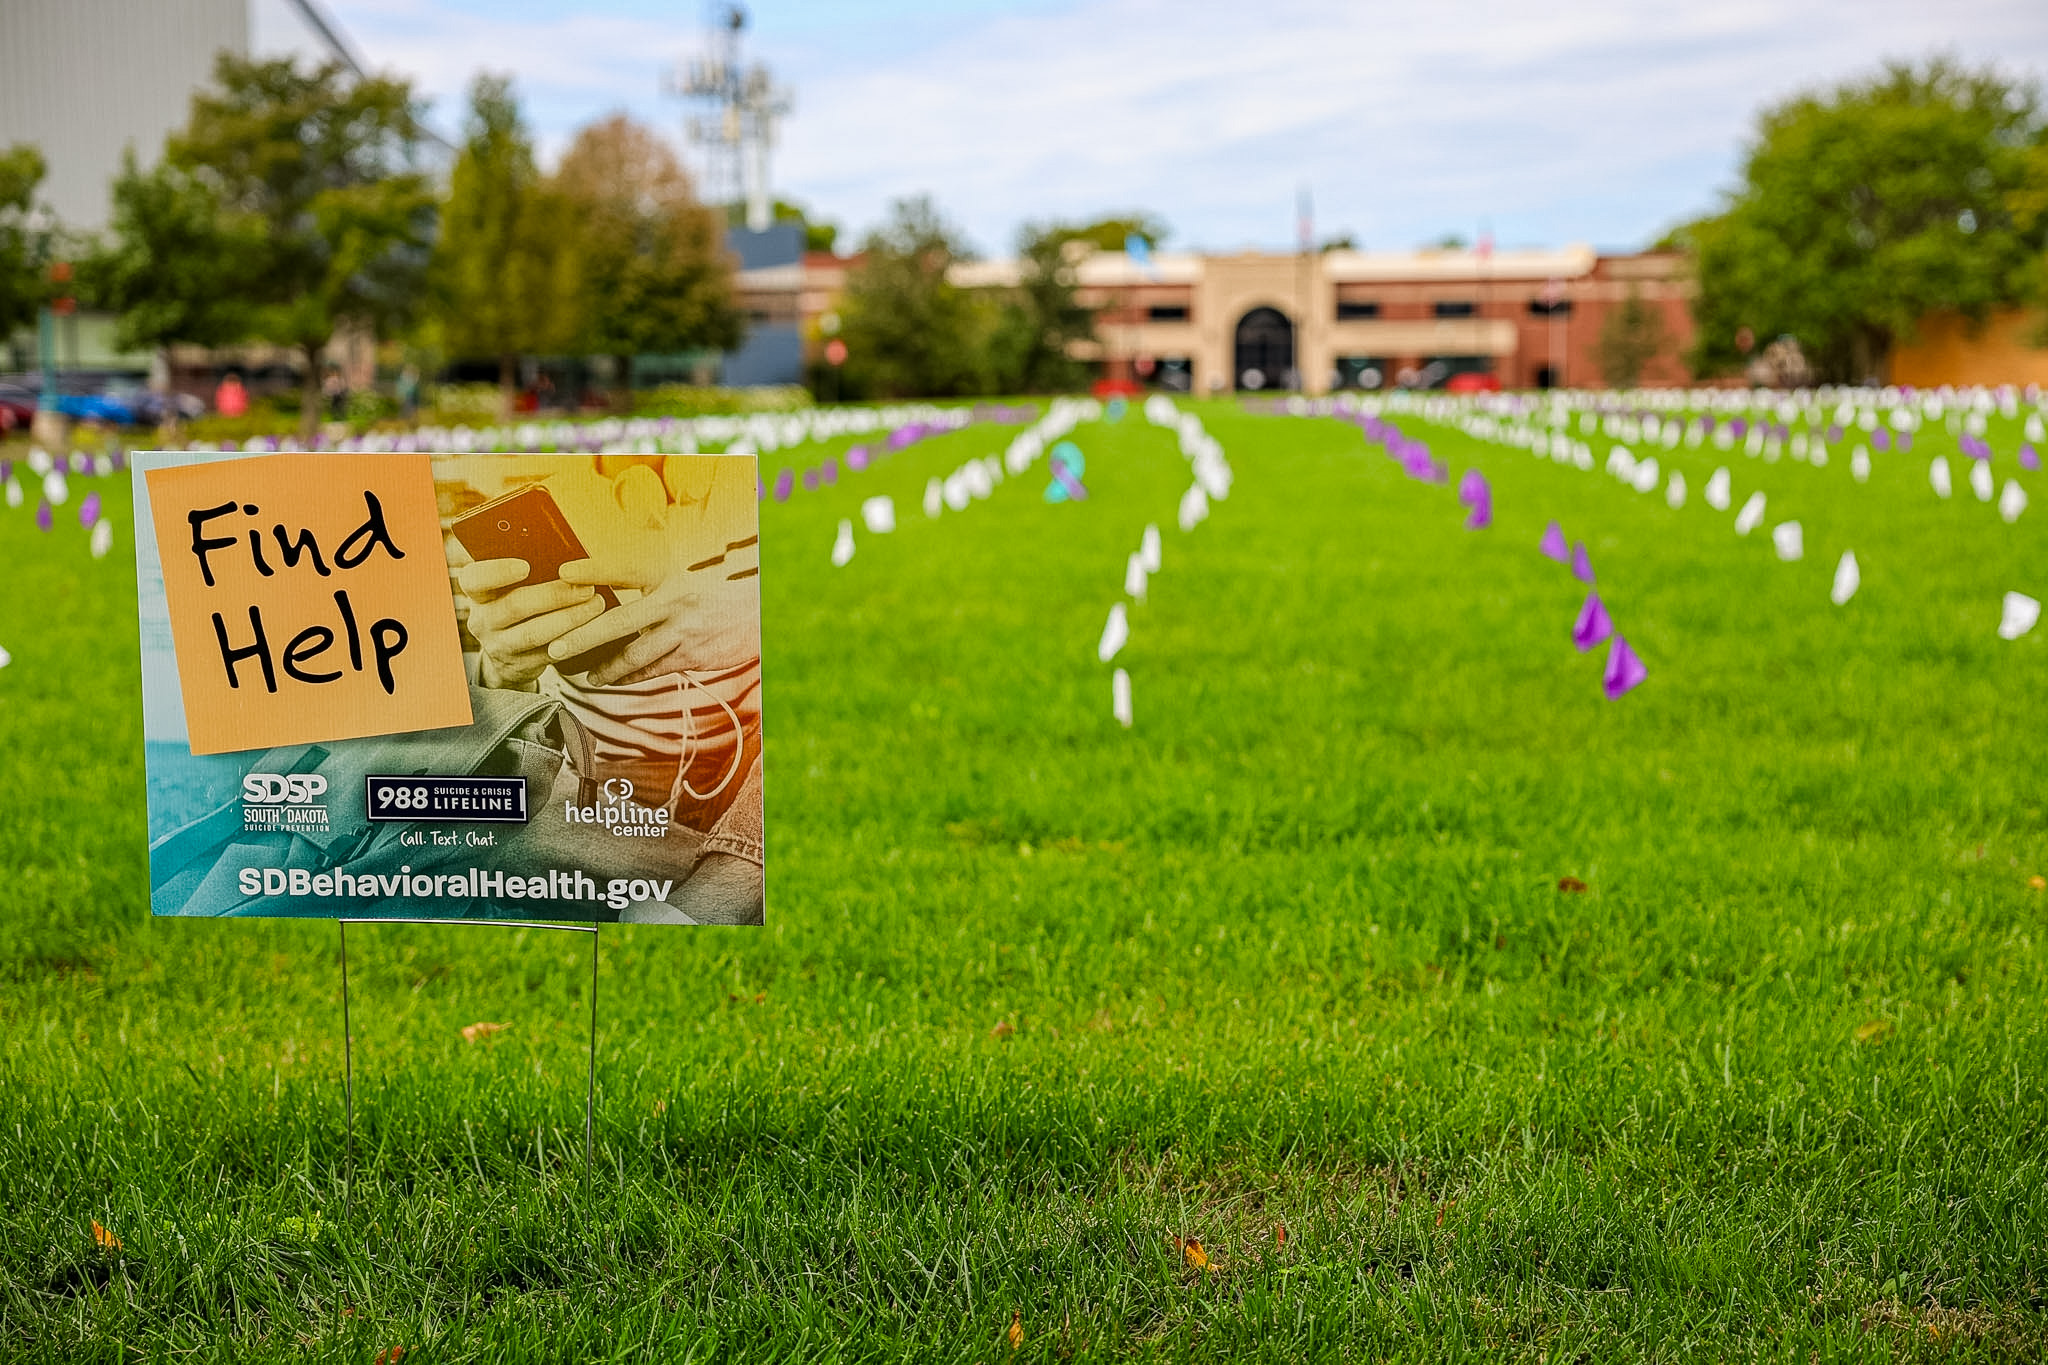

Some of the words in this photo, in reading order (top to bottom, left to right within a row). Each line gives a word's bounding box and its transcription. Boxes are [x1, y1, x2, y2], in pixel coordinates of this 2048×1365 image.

[188, 490, 405, 587] Find
[212, 590, 409, 695] Help
[242, 773, 328, 804] SDSP
[377, 786, 429, 810] 988
[434, 787, 471, 796] SUICIDE
[473, 787, 480, 796] &
[481, 787, 512, 796] CRISIS
[434, 797, 513, 811] LIFELINE
[243, 808, 280, 824] SOUTH
[287, 808, 329, 824] DAKOTA
[565, 800, 669, 829] helpline
[244, 824, 279, 832] SUICIDE
[280, 824, 330, 833] PREVENTION
[612, 824, 669, 838] center
[400, 831, 427, 846] Call.
[430, 831, 462, 847] Text.
[465, 831, 498, 847] Chat.
[238, 865, 674, 910] SDBehavioralHealth.gov
